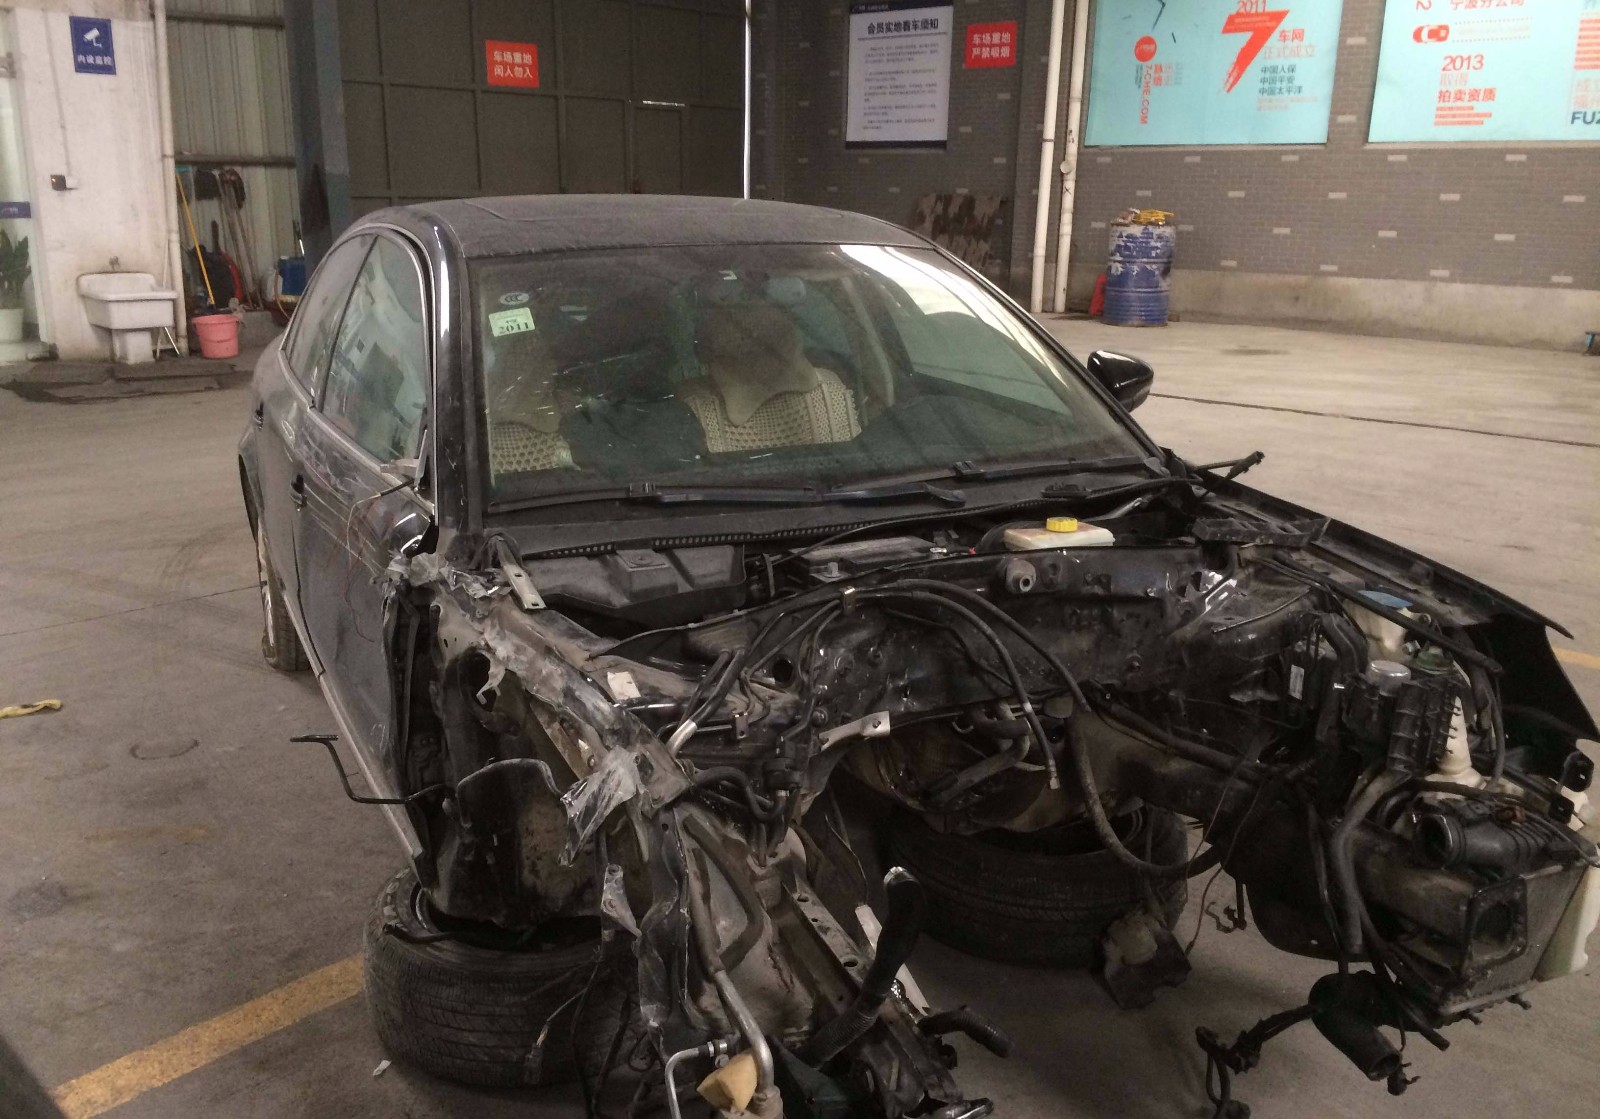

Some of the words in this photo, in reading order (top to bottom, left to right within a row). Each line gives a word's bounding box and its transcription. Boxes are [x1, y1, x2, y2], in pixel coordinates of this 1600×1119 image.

[867, 18, 939, 35] 会员实地看车须知
[973, 31, 1011, 45] 车场重地
[1279, 29, 1304, 42] 车网
[494, 51, 533, 65] 车场重地
[971, 46, 1011, 59] 严禁吸烟
[1261, 64, 1296, 74] 中国人保
[1442, 54, 1484, 71] 2013
[494, 65, 533, 79] 闲人勿入
[1259, 75, 1295, 85] 中国平安
[1140, 64, 1153, 124] 7-CHE.COM
[1258, 86, 1303, 96] 中国太平洋
[1438, 88, 1496, 103] 拍卖资质
[499, 322, 529, 334] 2011
